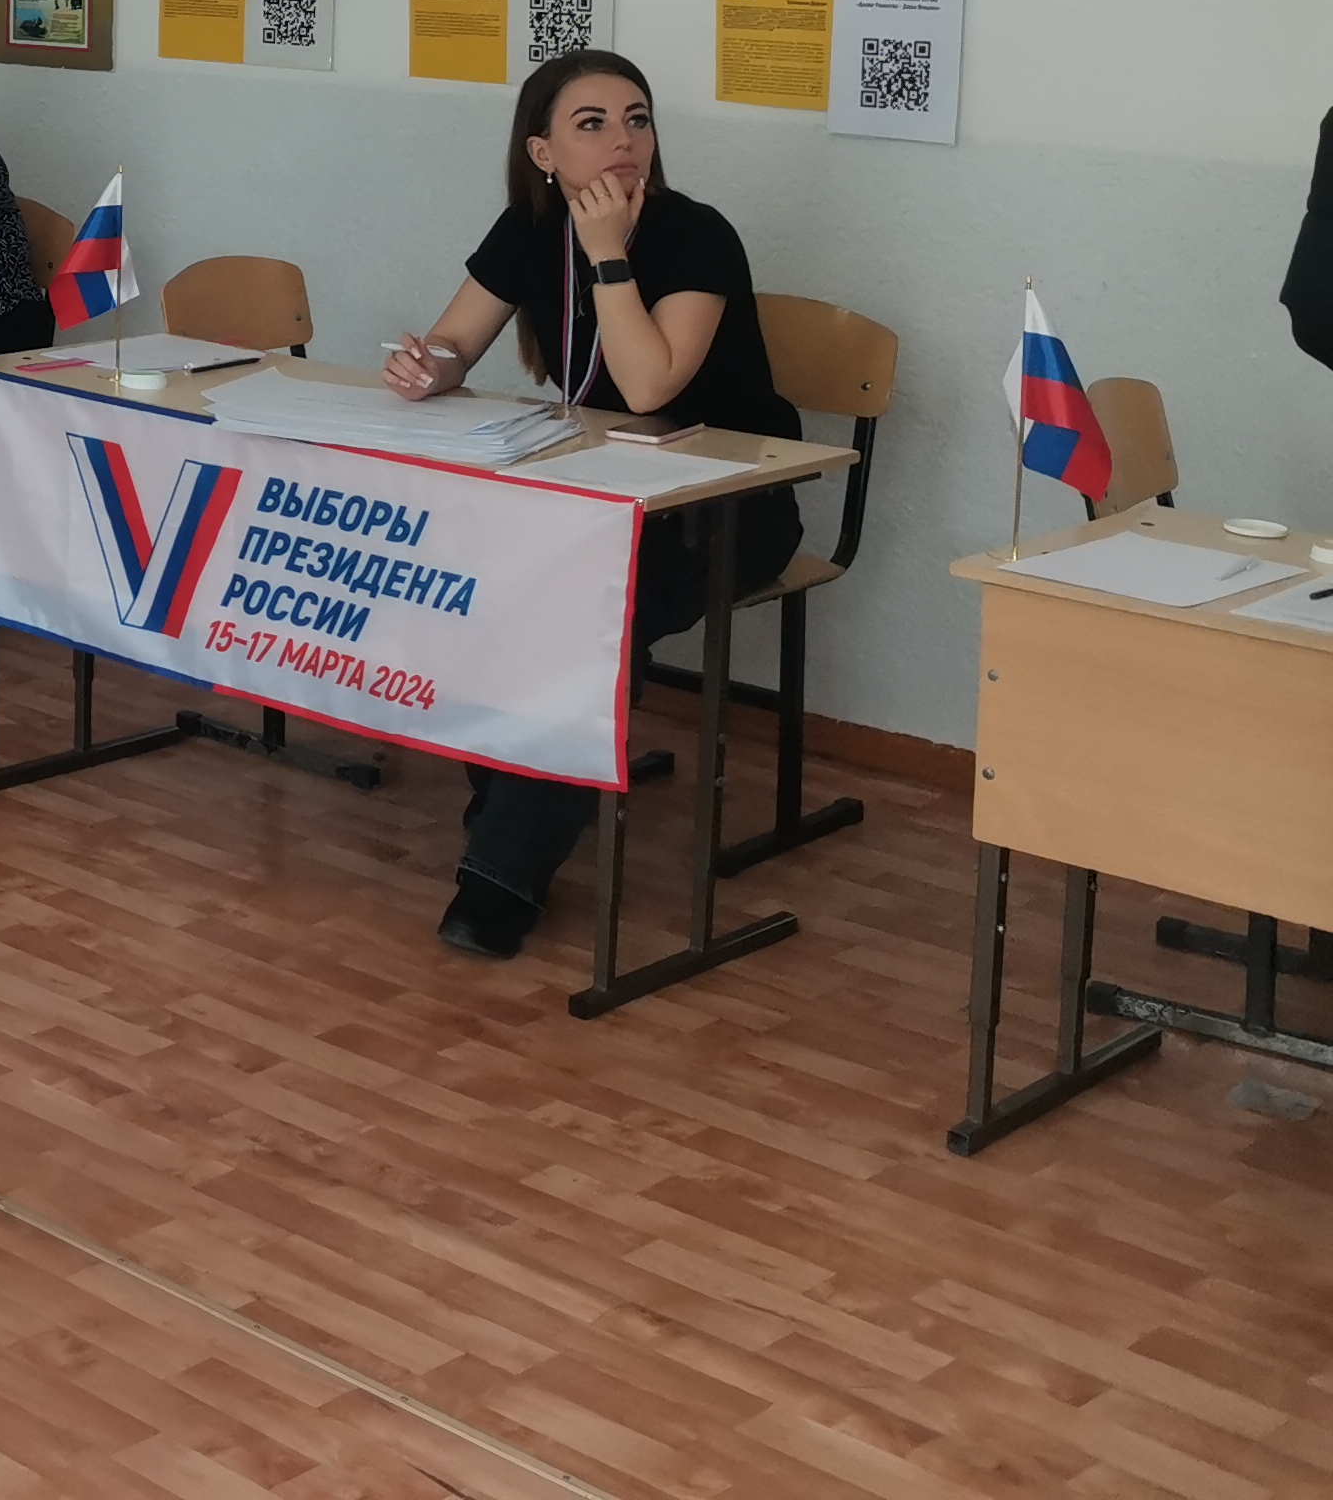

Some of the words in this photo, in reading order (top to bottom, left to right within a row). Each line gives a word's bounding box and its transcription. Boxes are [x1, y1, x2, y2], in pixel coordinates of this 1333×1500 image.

[255, 477, 429, 547] ВЫБОРЫ
[238, 525, 477, 617] ПРЕЗИДЕНТА
[220, 573, 371, 642] РОССИИ
[277, 645, 365, 692] МАРТА
[369, 665, 435, 711] 2024
